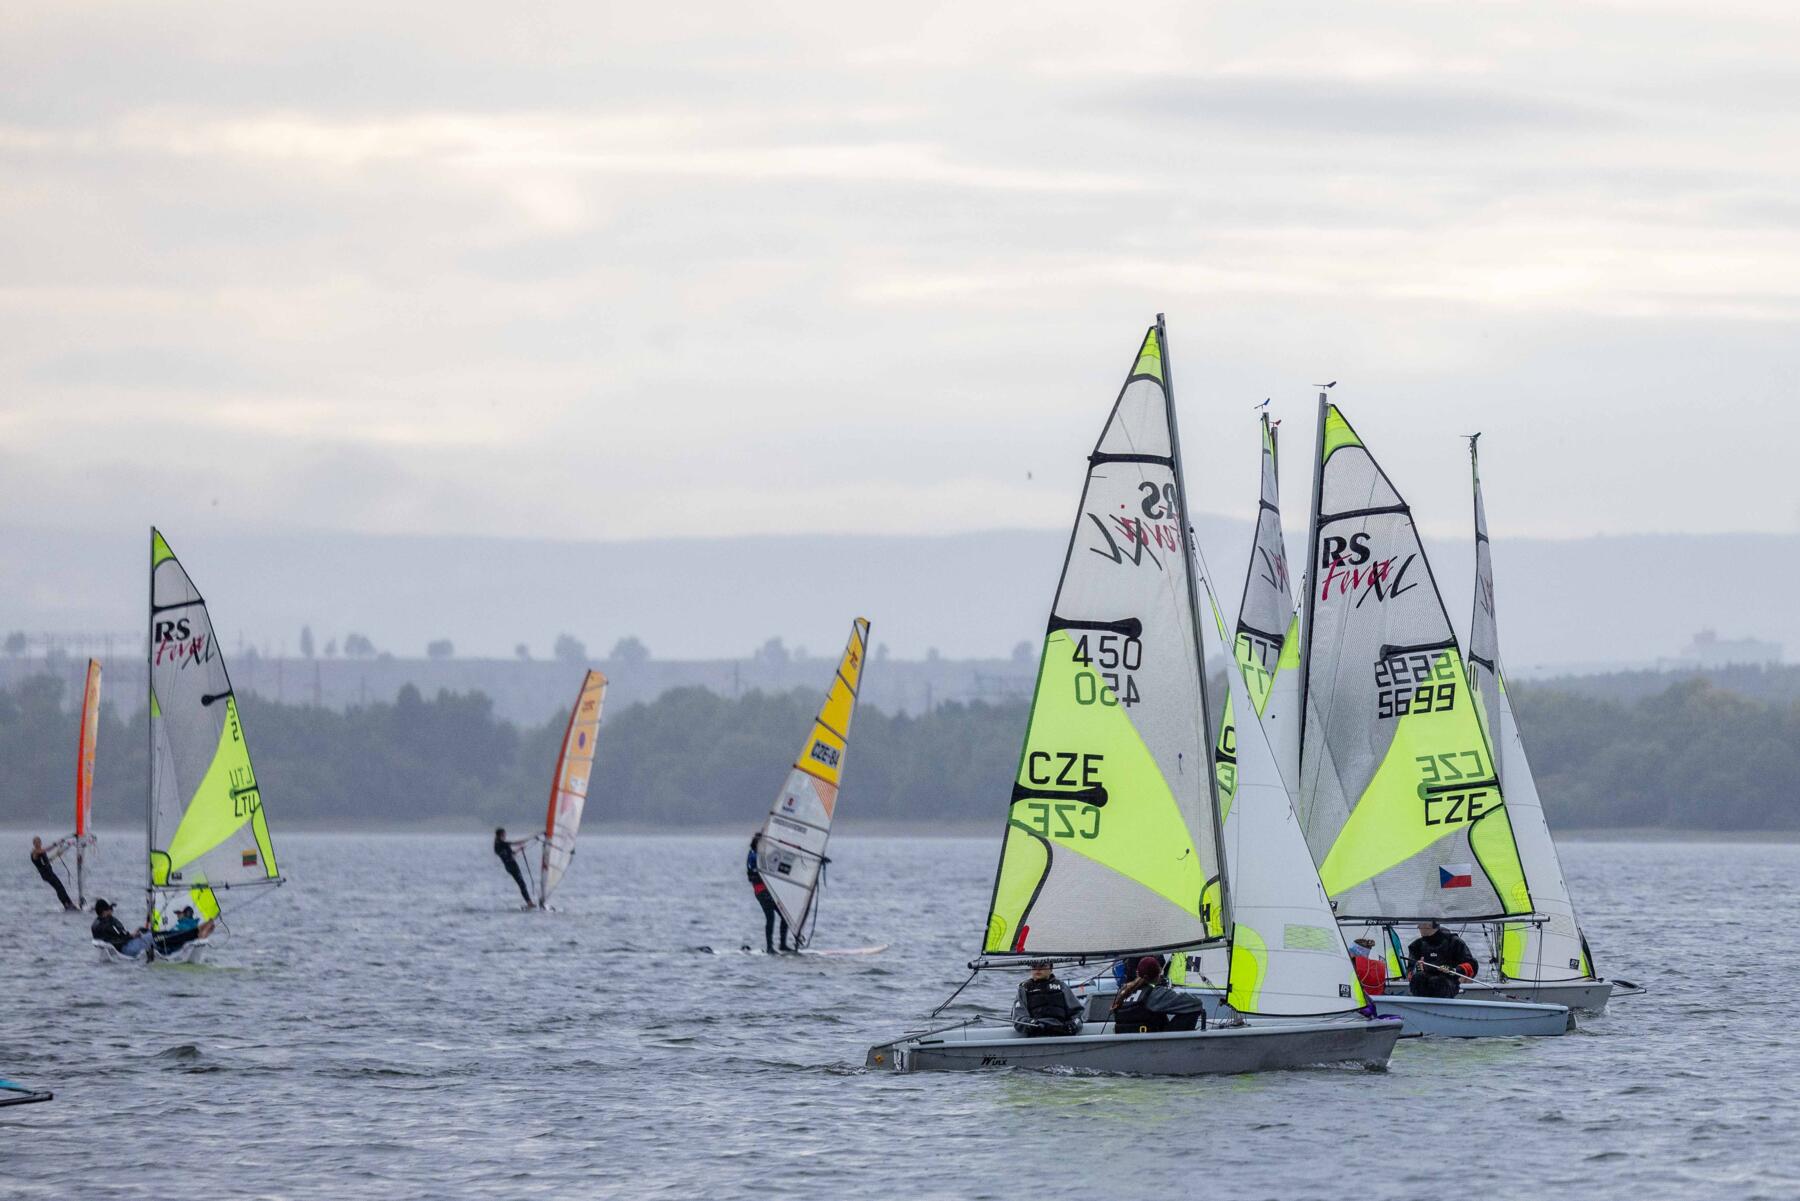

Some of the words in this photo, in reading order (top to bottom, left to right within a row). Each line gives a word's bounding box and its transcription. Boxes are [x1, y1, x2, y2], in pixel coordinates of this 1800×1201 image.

[1322, 532, 1371, 569] RS
[1322, 553, 1394, 601] Feva
[1356, 553, 1418, 609] XL
[155, 618, 191, 643] RS
[1072, 634, 1142, 671] 450
[1378, 683, 1456, 719] 5699
[1029, 751, 1104, 787] CZE
[235, 793, 257, 818] LTU
[1425, 792, 1488, 827] CZE
